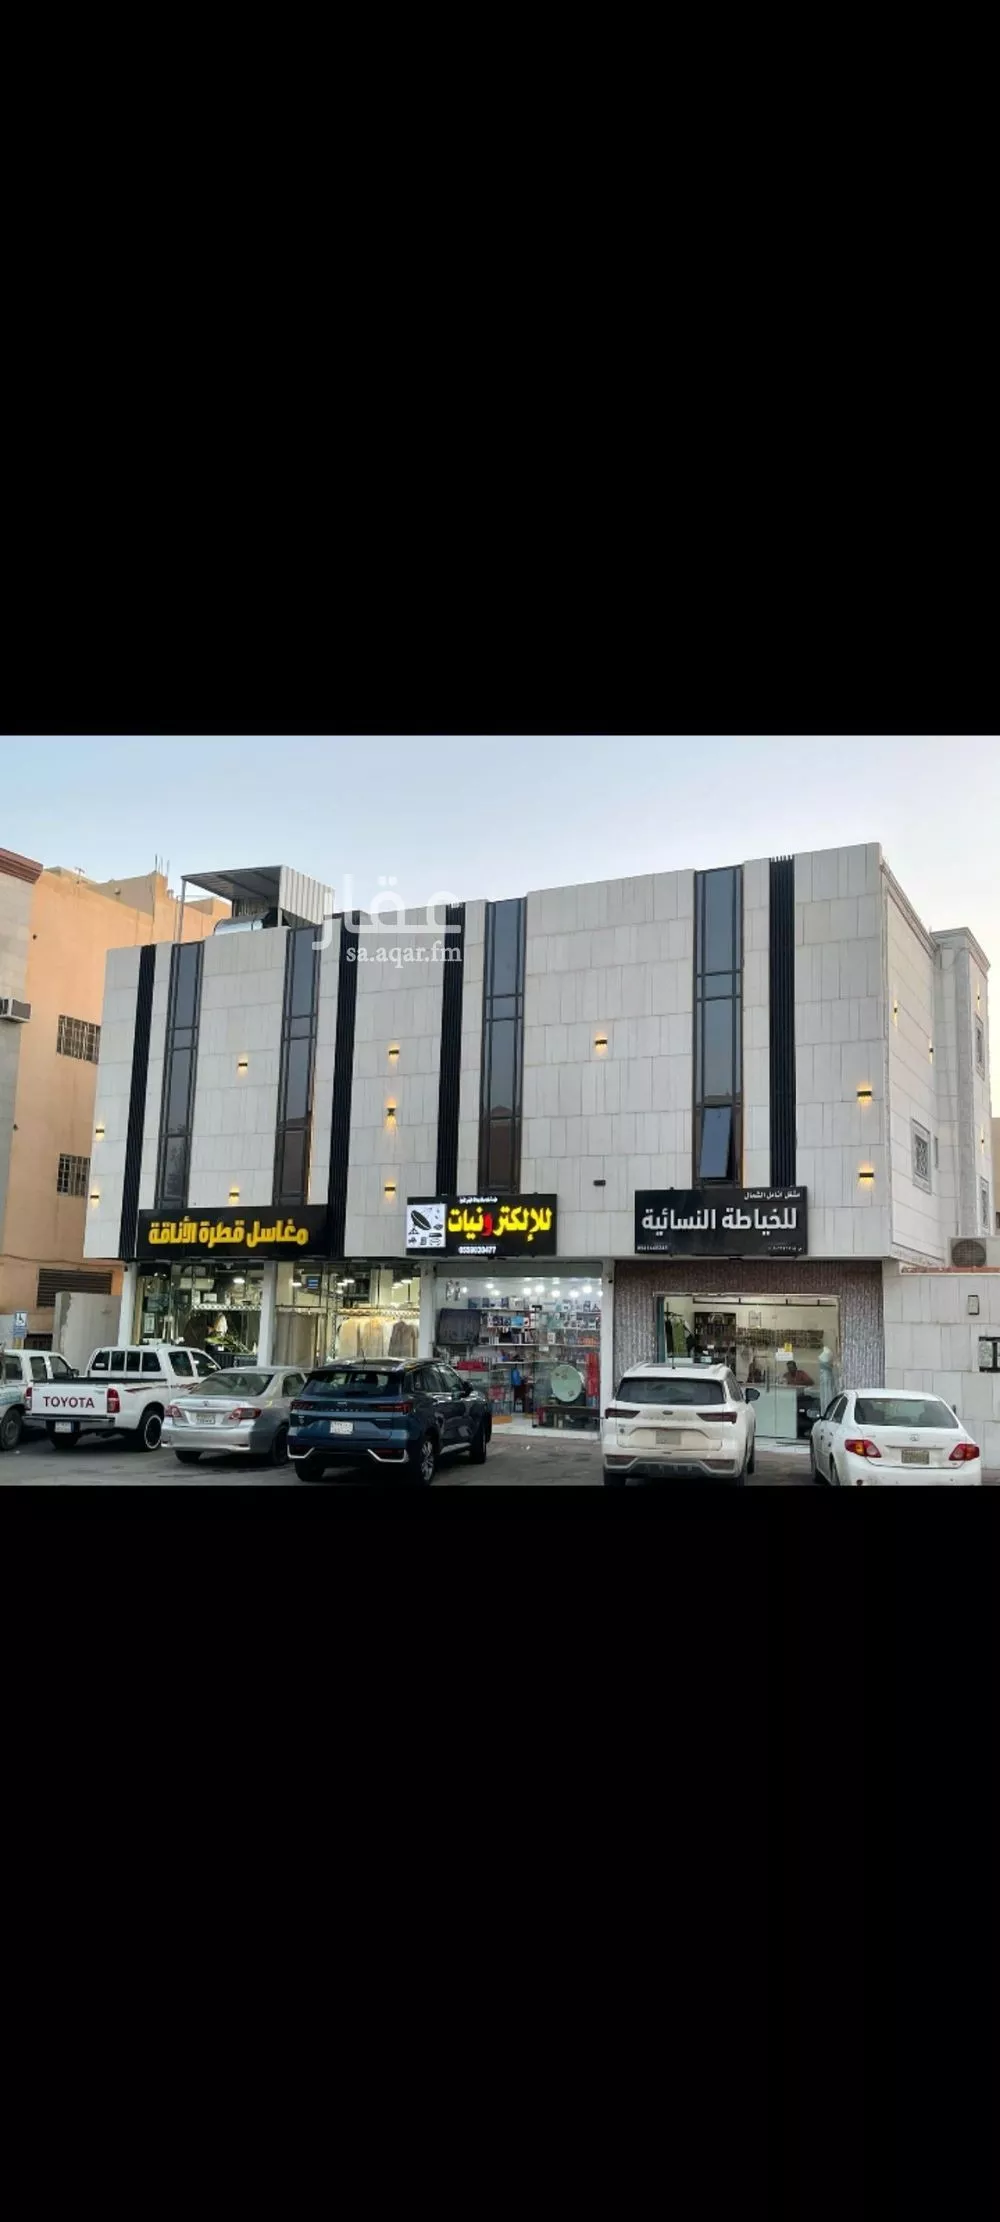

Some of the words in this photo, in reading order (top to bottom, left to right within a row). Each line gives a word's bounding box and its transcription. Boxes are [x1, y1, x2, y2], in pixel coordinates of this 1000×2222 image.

[744, 1191, 766, 1201] الشمال
[148, 1215, 198, 1245] الأناقة
[198, 1218, 245, 1249] قطرة
[246, 1218, 309, 1249] مغاسل
[447, 1204, 553, 1242] للإلكترونيات
[641, 1207, 717, 1237] النسائية
[721, 1207, 797, 1237] للخياطة
[43, 1396, 95, 1409] TOYOTA
